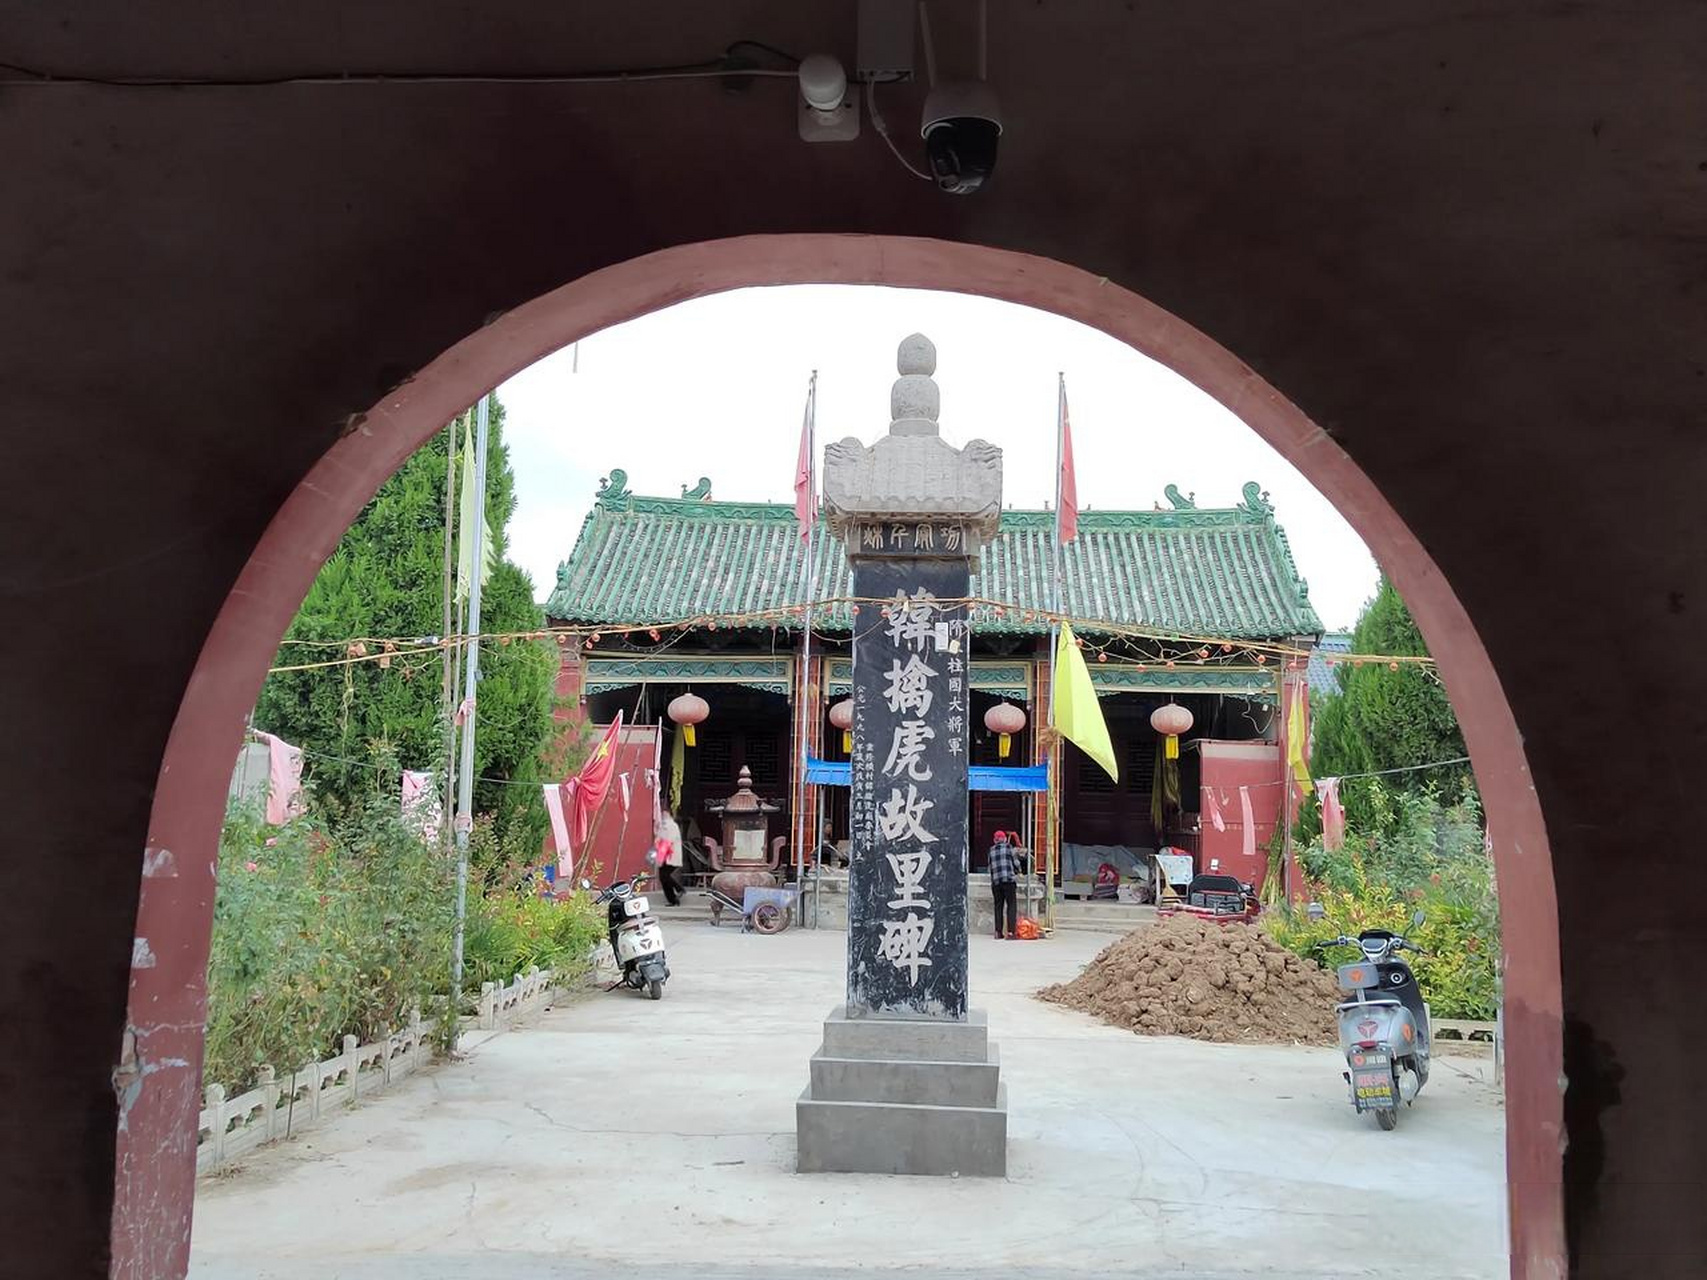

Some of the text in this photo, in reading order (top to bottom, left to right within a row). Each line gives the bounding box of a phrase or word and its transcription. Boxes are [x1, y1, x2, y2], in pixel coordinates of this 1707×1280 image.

[877, 586, 940, 988] 韓擒虎故里碑
